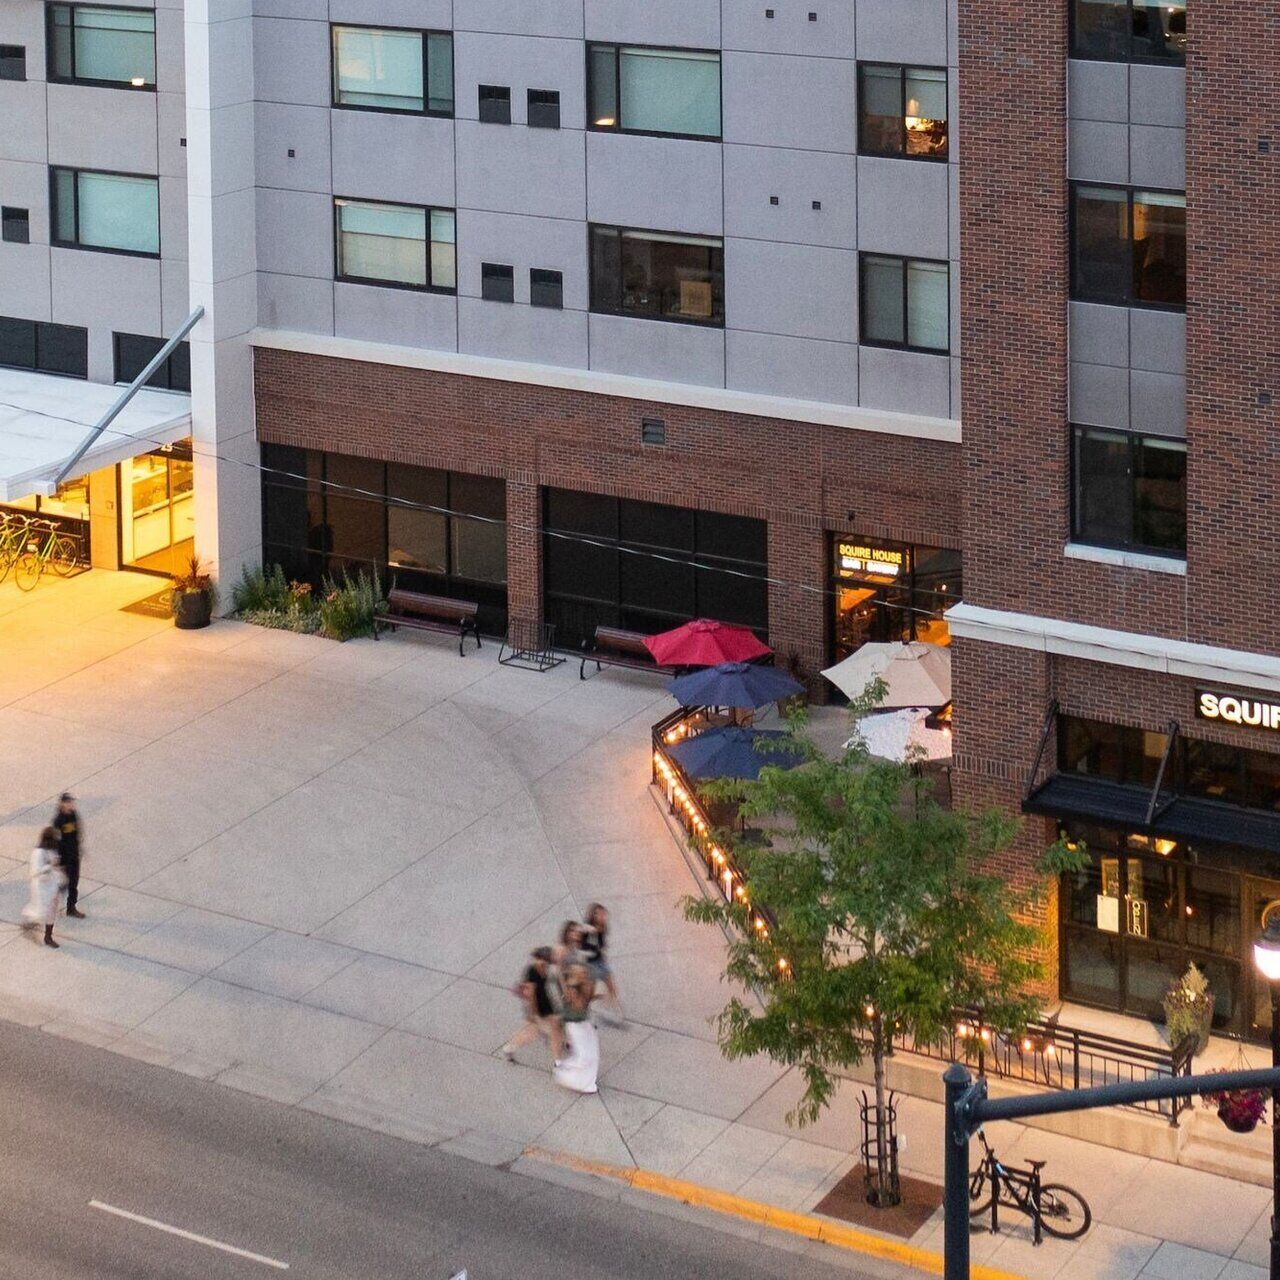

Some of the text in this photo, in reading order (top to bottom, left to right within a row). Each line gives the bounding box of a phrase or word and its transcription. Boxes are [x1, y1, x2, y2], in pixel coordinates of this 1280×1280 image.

[839, 544, 902, 564] SQUIRE HOUSE
[1133, 900, 1141, 936] OPEN
